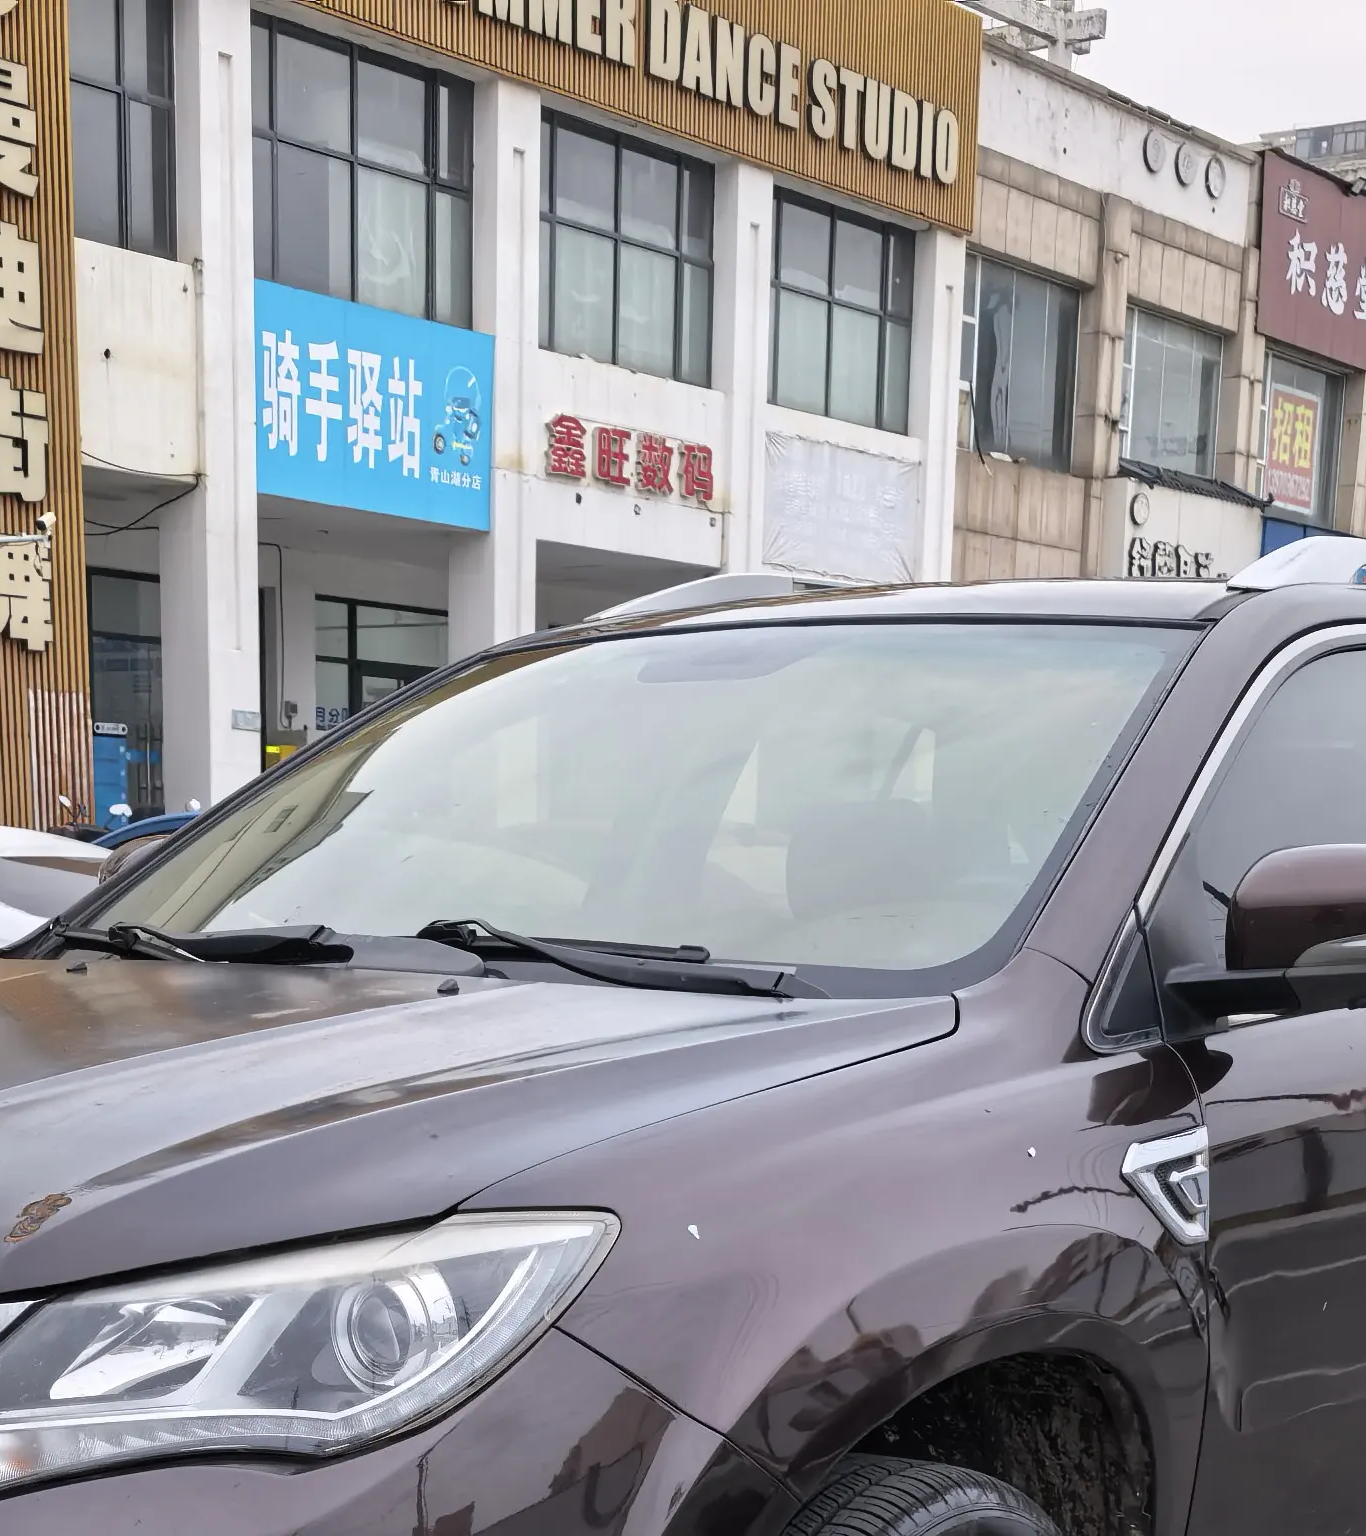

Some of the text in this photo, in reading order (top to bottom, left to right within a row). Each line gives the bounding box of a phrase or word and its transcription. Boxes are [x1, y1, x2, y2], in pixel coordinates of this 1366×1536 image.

[644, 0, 802, 129] DANCE
[808, 56, 959, 187] STUDIO
[261, 329, 423, 480] 骑手驿站
[1271, 396, 1314, 469] 招租
[428, 465, 483, 491] 青山湖分店
[543, 412, 714, 502] 鑫旺数码
